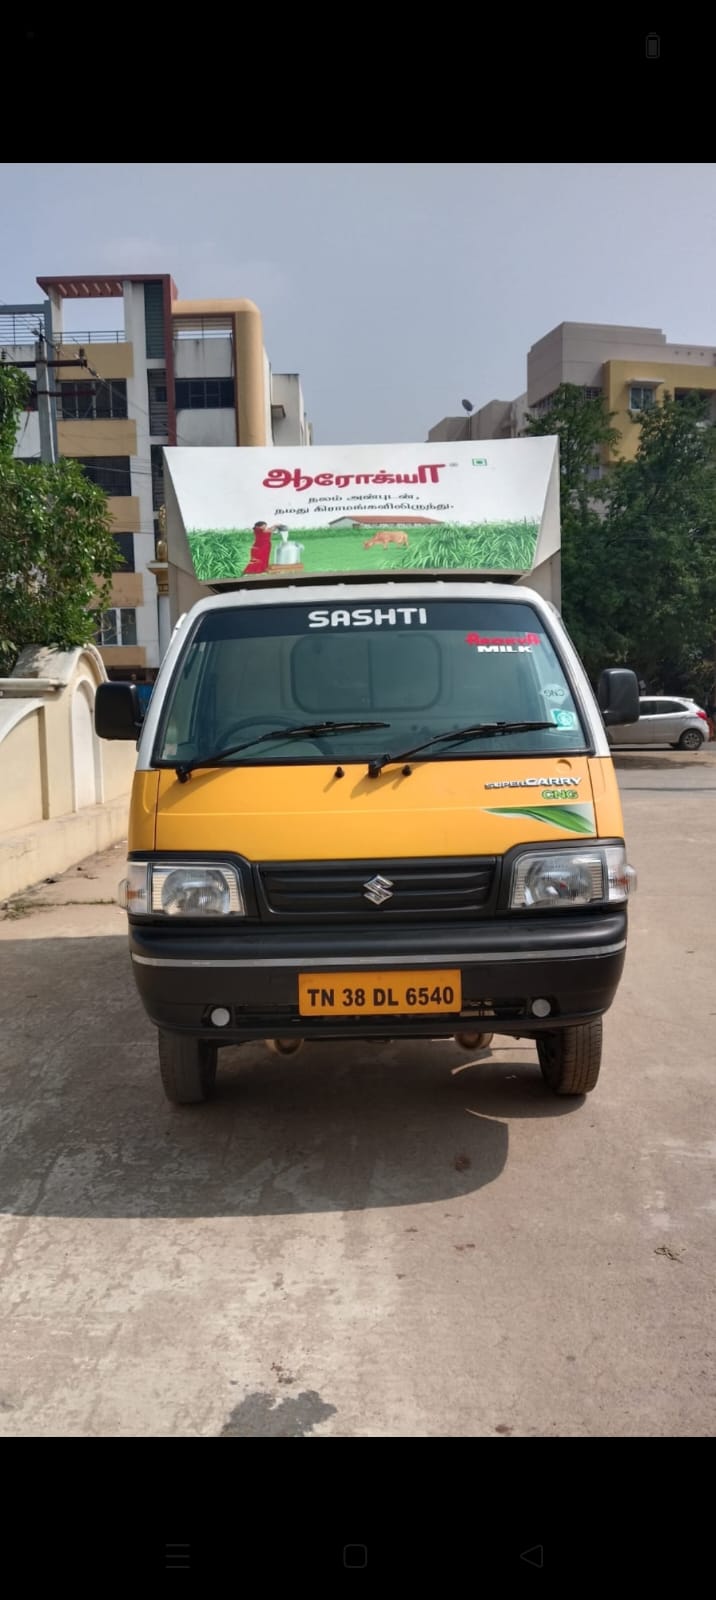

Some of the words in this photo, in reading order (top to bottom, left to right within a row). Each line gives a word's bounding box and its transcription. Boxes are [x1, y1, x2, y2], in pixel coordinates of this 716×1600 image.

[262, 464, 446, 492] ஆரோக்யா
[307, 607, 427, 628] SASHTI
[477, 645, 533, 653] MILK
[541, 789, 579, 800] CNG
[307, 988, 335, 1007] TN
[342, 988, 366, 1007] 38
[373, 987, 399, 1007] DL
[405, 986, 454, 1006] 6540
